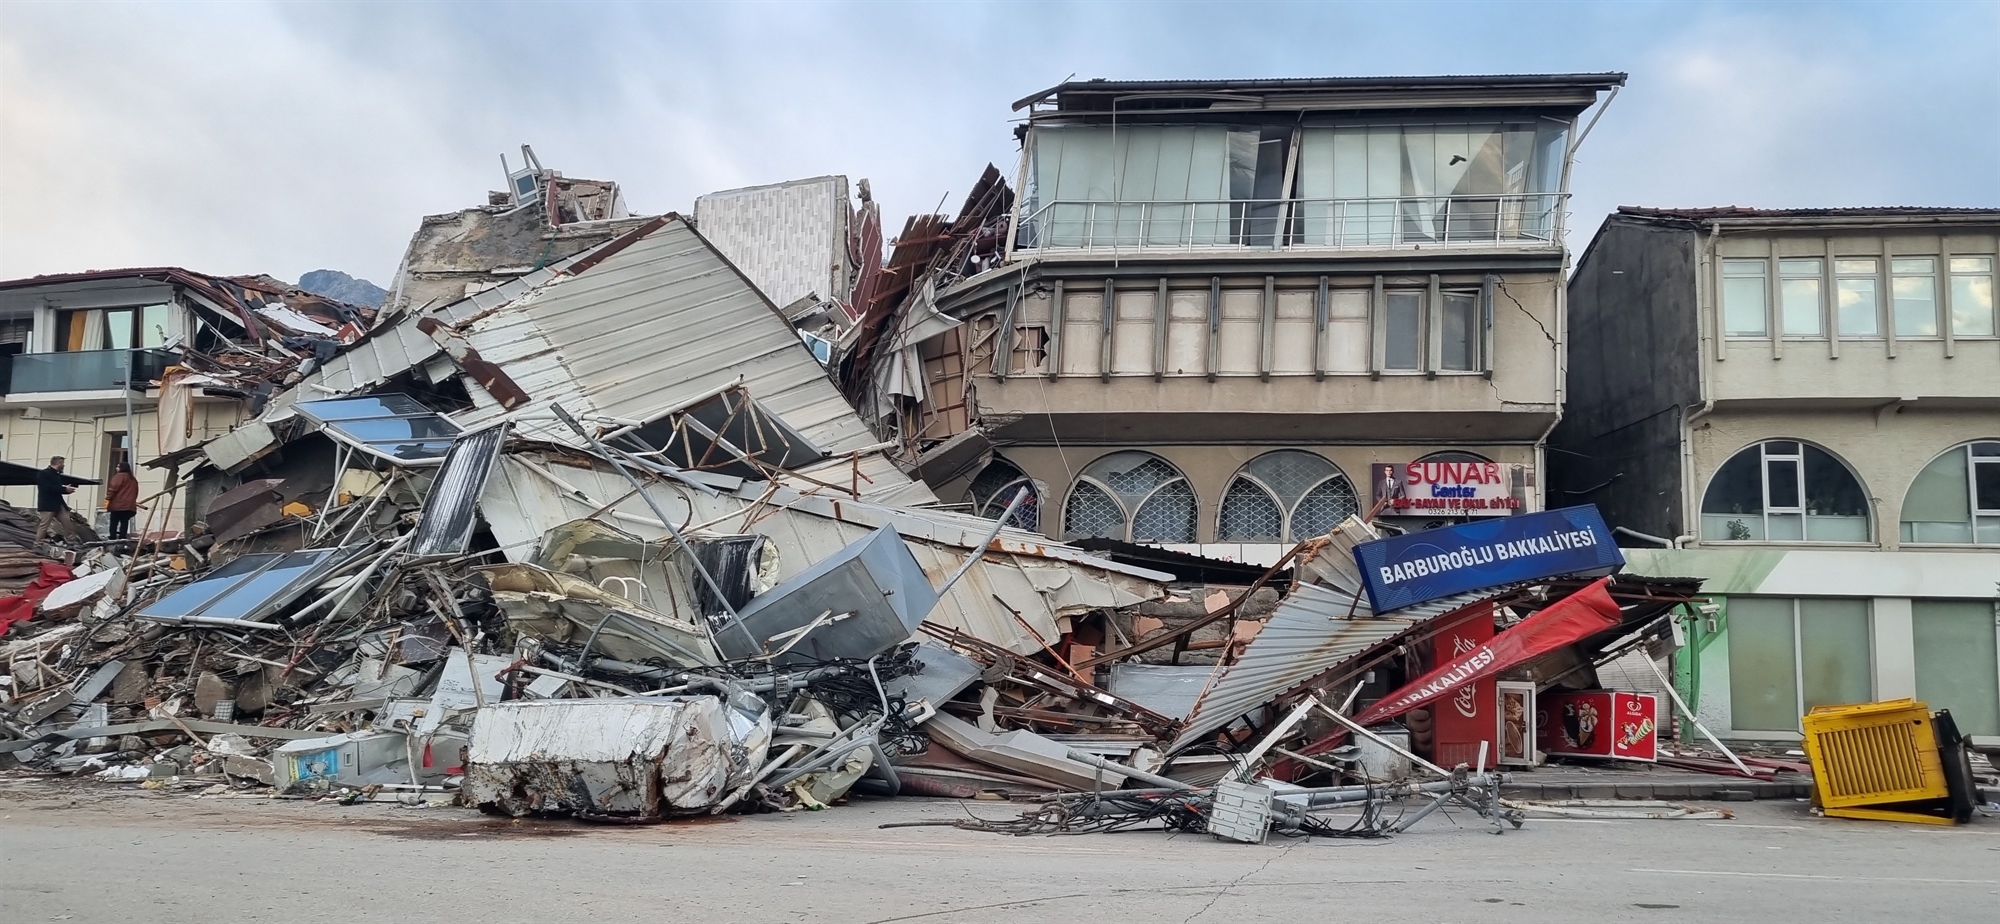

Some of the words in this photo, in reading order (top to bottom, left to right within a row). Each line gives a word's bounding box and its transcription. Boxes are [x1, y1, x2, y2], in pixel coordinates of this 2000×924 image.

[1406, 462, 1501, 485] SUNAR
[1431, 483, 1477, 498] Center
[1447, 499, 1461, 509] VE
[1462, 499, 1489, 509] OKUL
[1380, 546, 1494, 585] BARBUROĞLU
[1496, 525, 1598, 561] BAKKALİYESİ
